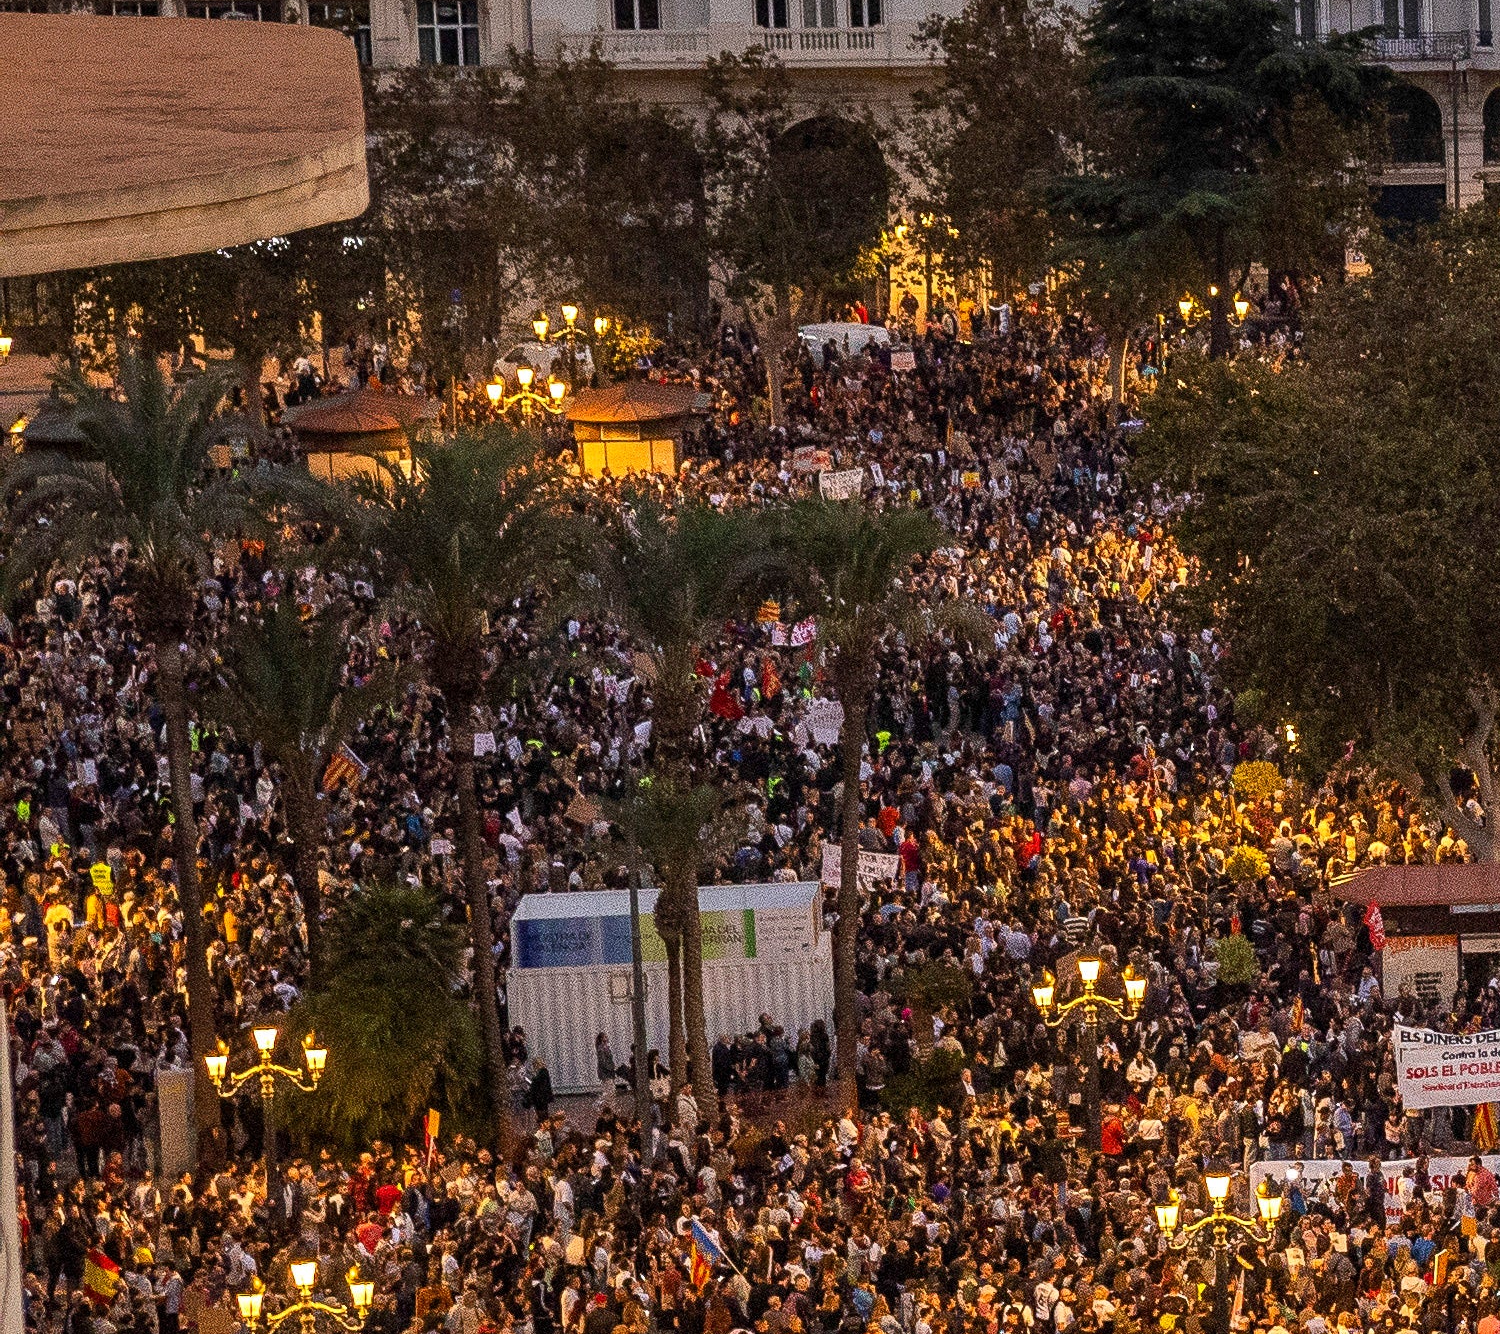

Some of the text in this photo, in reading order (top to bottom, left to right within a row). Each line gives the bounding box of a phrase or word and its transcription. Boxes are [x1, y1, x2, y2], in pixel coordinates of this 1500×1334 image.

[1400, 1030, 1421, 1043] ELS
[1406, 1067, 1438, 1080] SOLS
[1441, 1066, 1456, 1077] EL
